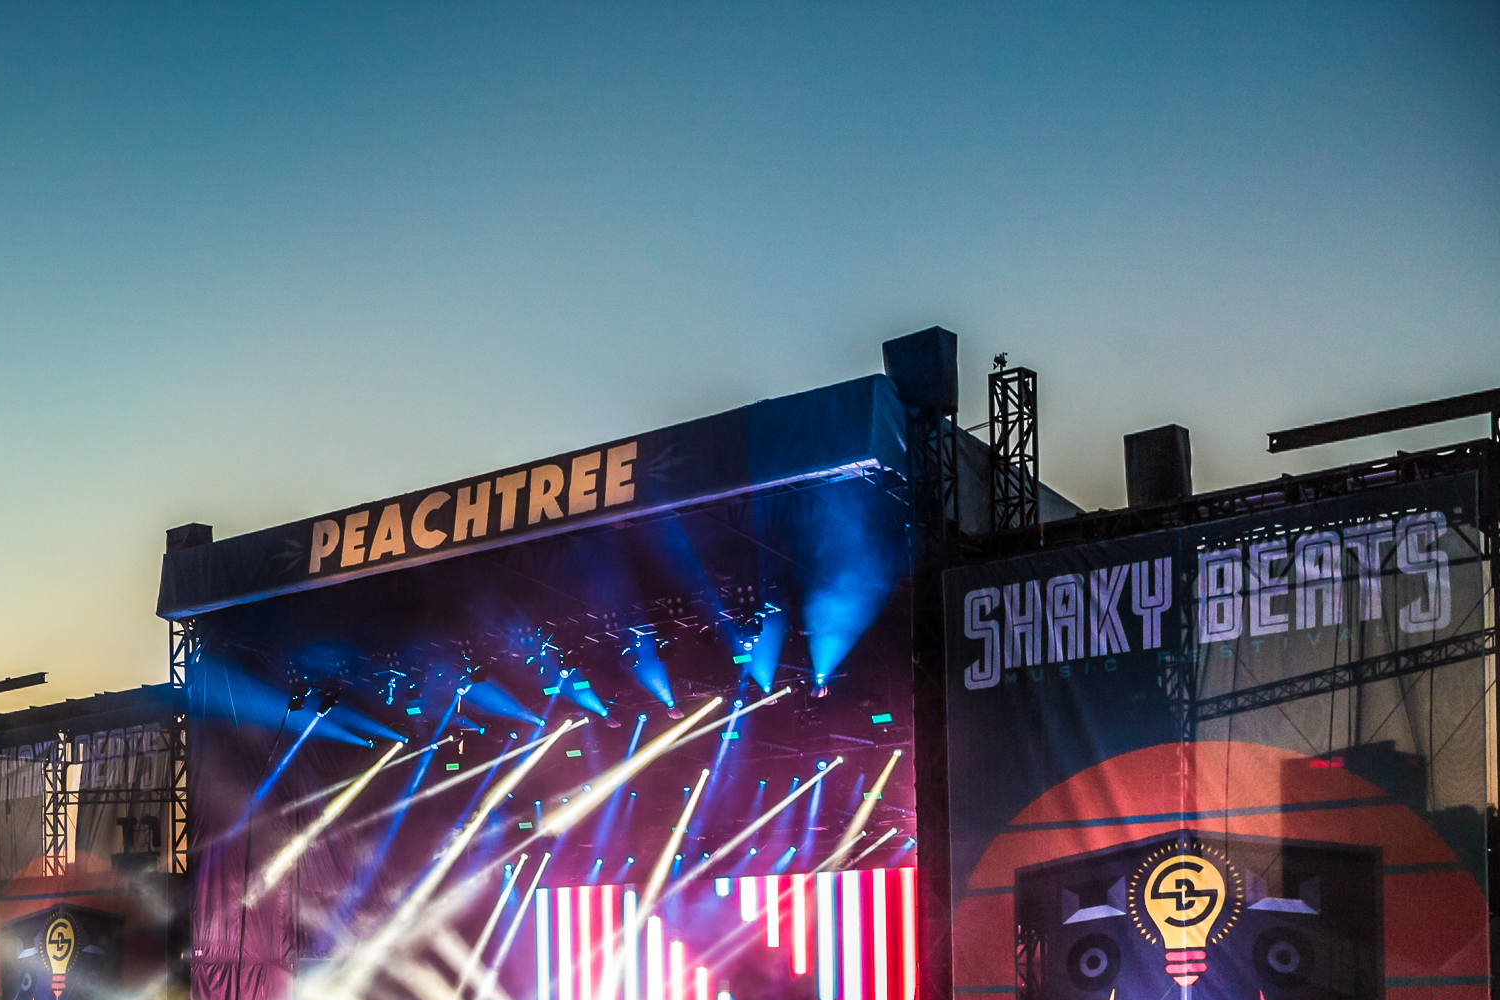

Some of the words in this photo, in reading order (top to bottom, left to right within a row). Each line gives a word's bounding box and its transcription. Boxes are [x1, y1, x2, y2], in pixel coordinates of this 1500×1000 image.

[308, 441, 638, 574] PEACHTREE
[963, 556, 1173, 692] SHAKY
[1197, 510, 1452, 644] BEATS
[1004, 657, 1118, 685] MUSIC
